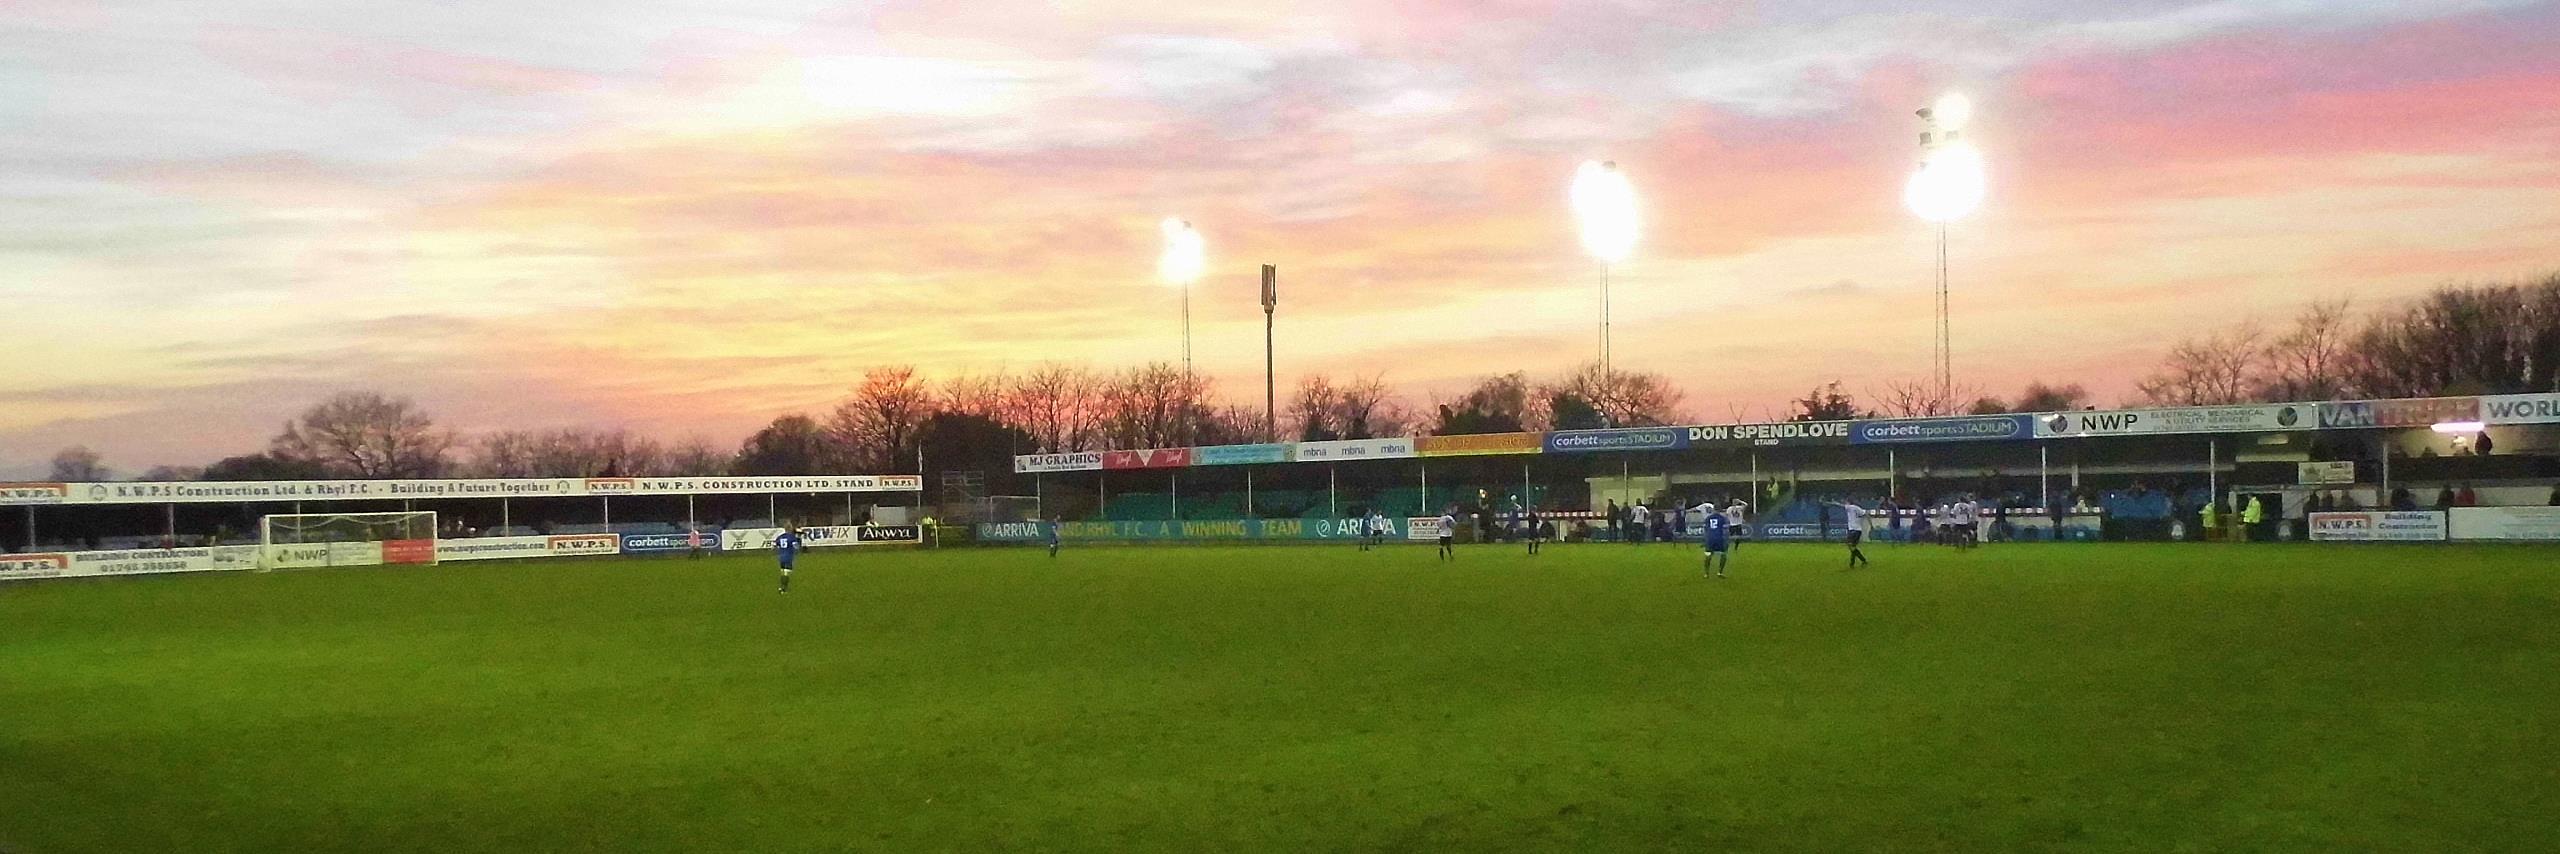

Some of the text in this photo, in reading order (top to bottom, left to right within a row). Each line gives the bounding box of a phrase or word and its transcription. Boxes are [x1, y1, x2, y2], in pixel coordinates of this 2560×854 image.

[2081, 414, 2138, 430] NWP
[1688, 423, 1849, 440] DON SPENDLOVE
[1754, 438, 1779, 446] STAND
[1303, 443, 1406, 457] mbna mbna mbna
[1029, 453, 1101, 466] MJ GRAPHICS
[177, 485, 269, 496] Construction
[391, 483, 444, 495] Building
[448, 483, 455, 492] A
[459, 482, 497, 493] Future
[501, 481, 550, 493] Together
[643, 481, 698, 490] N.W.P.S.
[703, 480, 802, 489] CONSTRUCTION
[807, 480, 833, 488] LTD.
[994, 522, 1040, 537] ARRIVA
[1160, 520, 1170, 536] A
[1182, 520, 1246, 536] WINNING
[1260, 520, 1300, 536] TEAM
[1337, 518, 1396, 535] ARA
[1709, 519, 1718, 528] 12
[76, 552, 129, 561] BUILDING
[131, 549, 209, 559] CONTRACTORS
[294, 550, 327, 561] NWP
